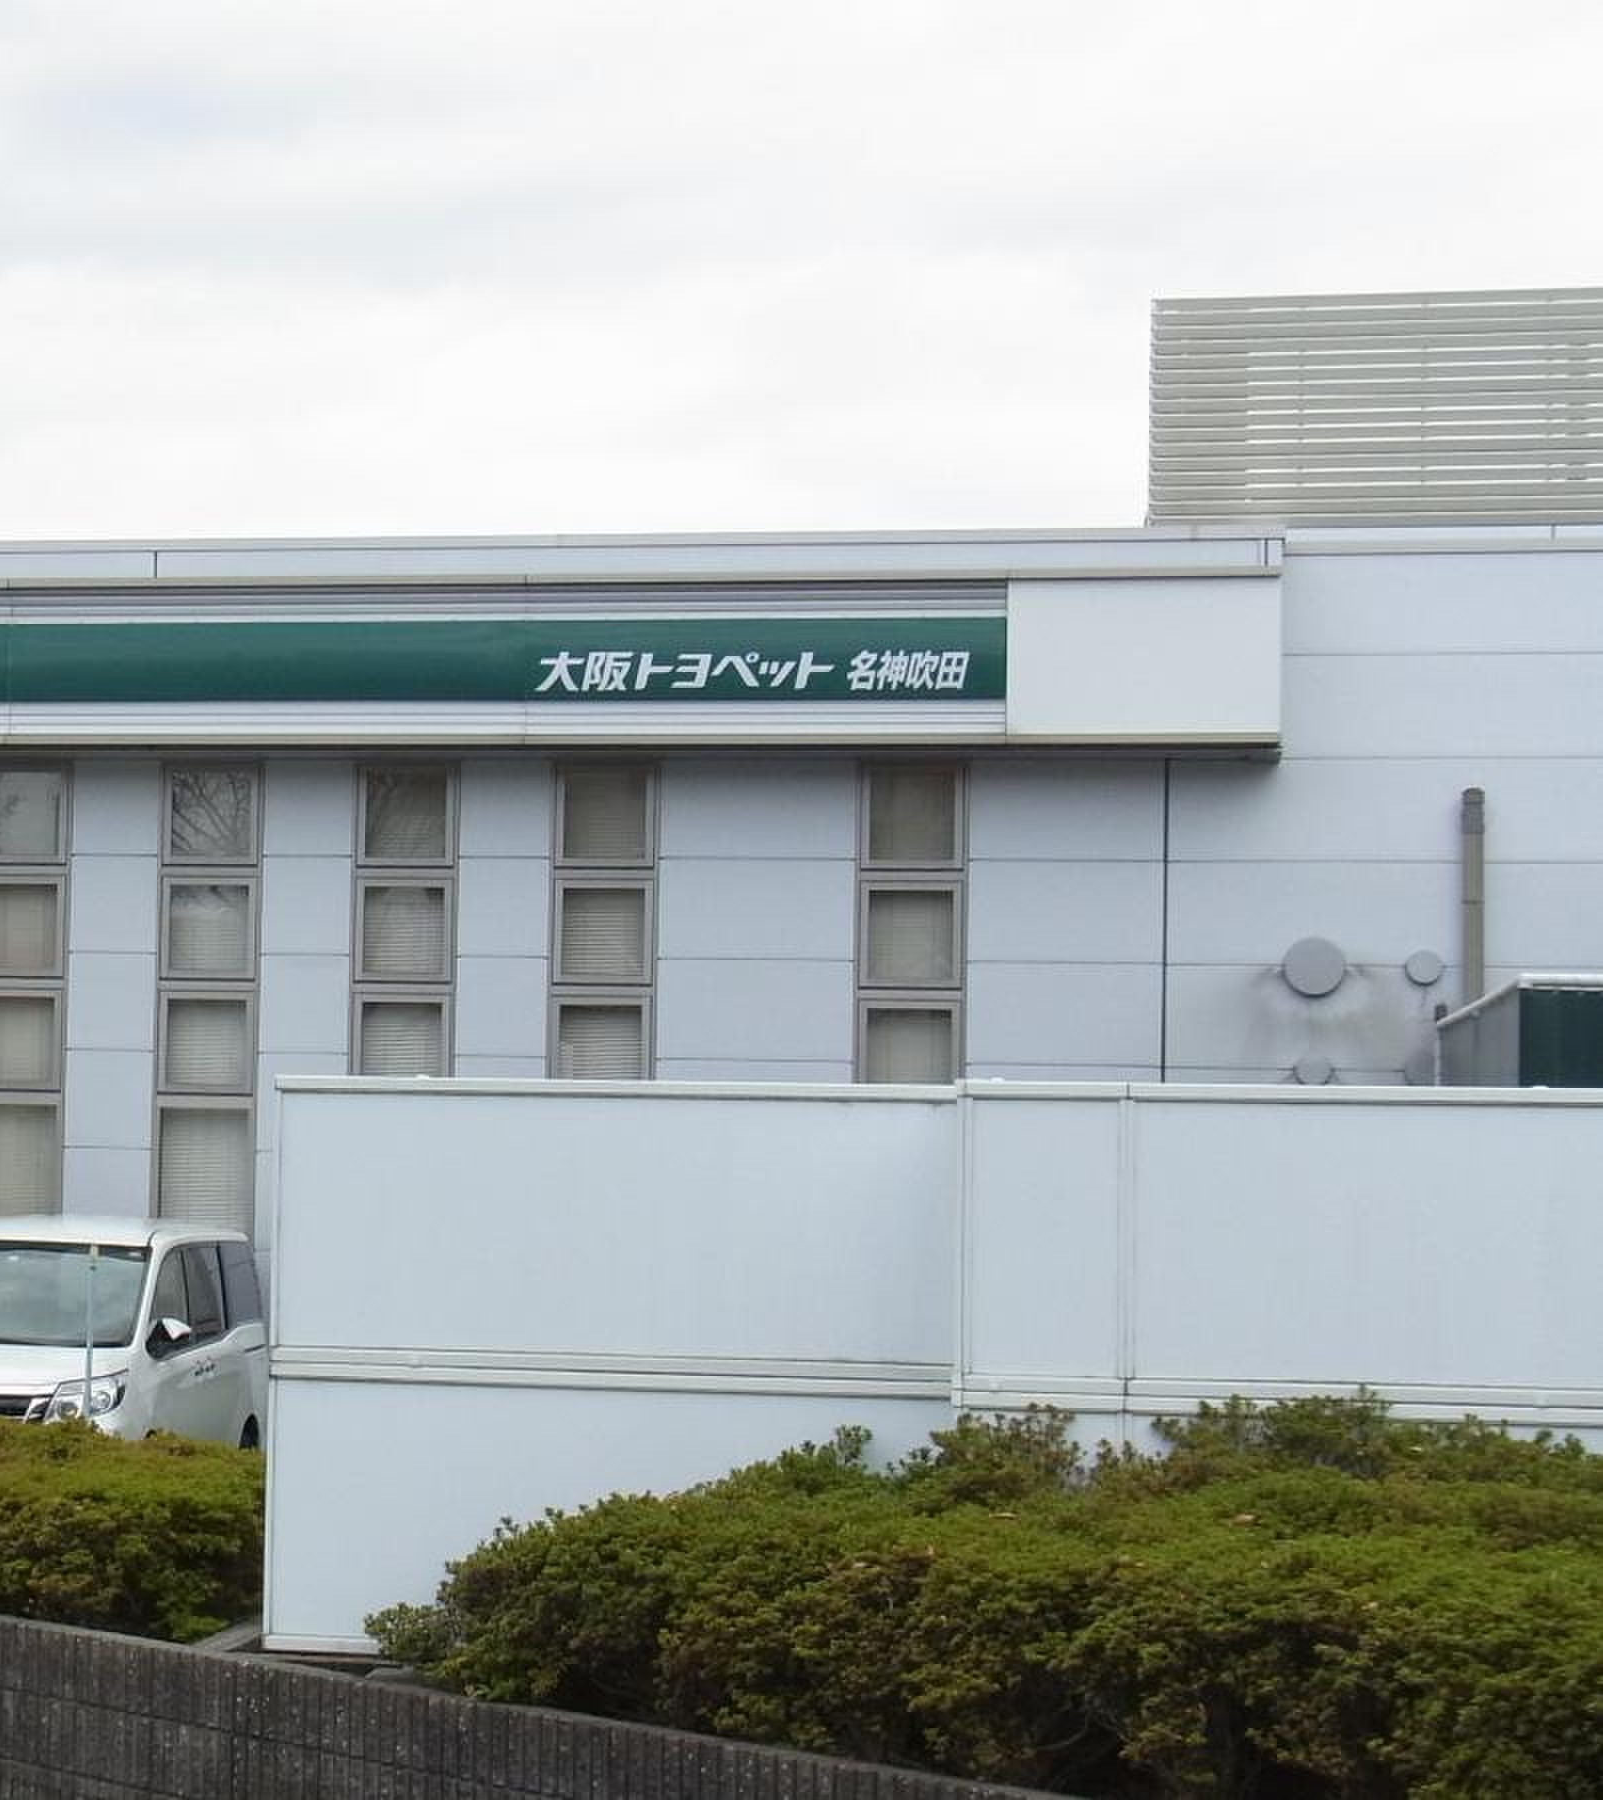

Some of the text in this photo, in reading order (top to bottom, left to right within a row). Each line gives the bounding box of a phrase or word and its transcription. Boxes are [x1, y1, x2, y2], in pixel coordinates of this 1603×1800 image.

[534, 650, 971, 692] 大阪トヨペット 名神吹田
